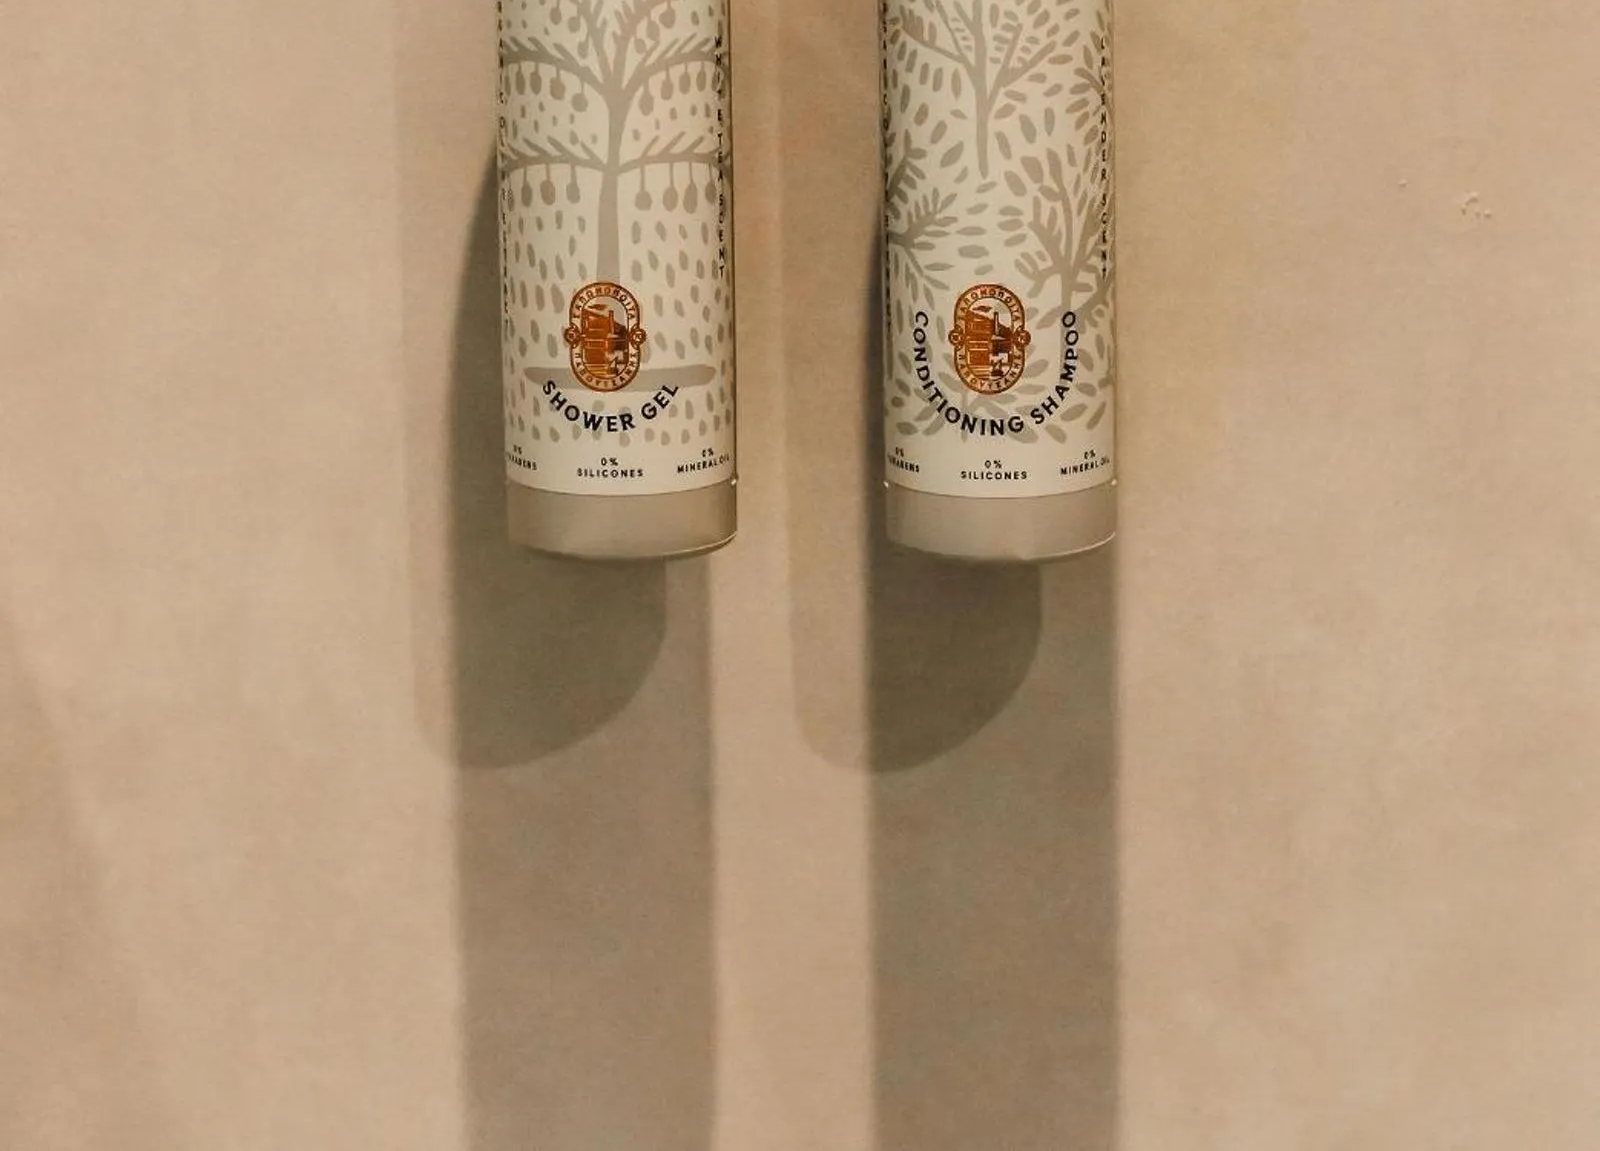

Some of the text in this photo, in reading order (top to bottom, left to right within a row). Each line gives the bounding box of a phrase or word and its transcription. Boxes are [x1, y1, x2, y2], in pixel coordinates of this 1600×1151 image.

[913, 311, 1079, 436] CONDITIONING SHAMPOO
[542, 380, 679, 432] SHOWER GEL
[600, 457, 619, 466] 0%
[677, 458, 718, 474] MINERAL
[984, 459, 1002, 469] 0%
[1060, 460, 1099, 475] MINERAL
[576, 468, 644, 478] SILICONES
[960, 470, 1028, 481] SILICONES
